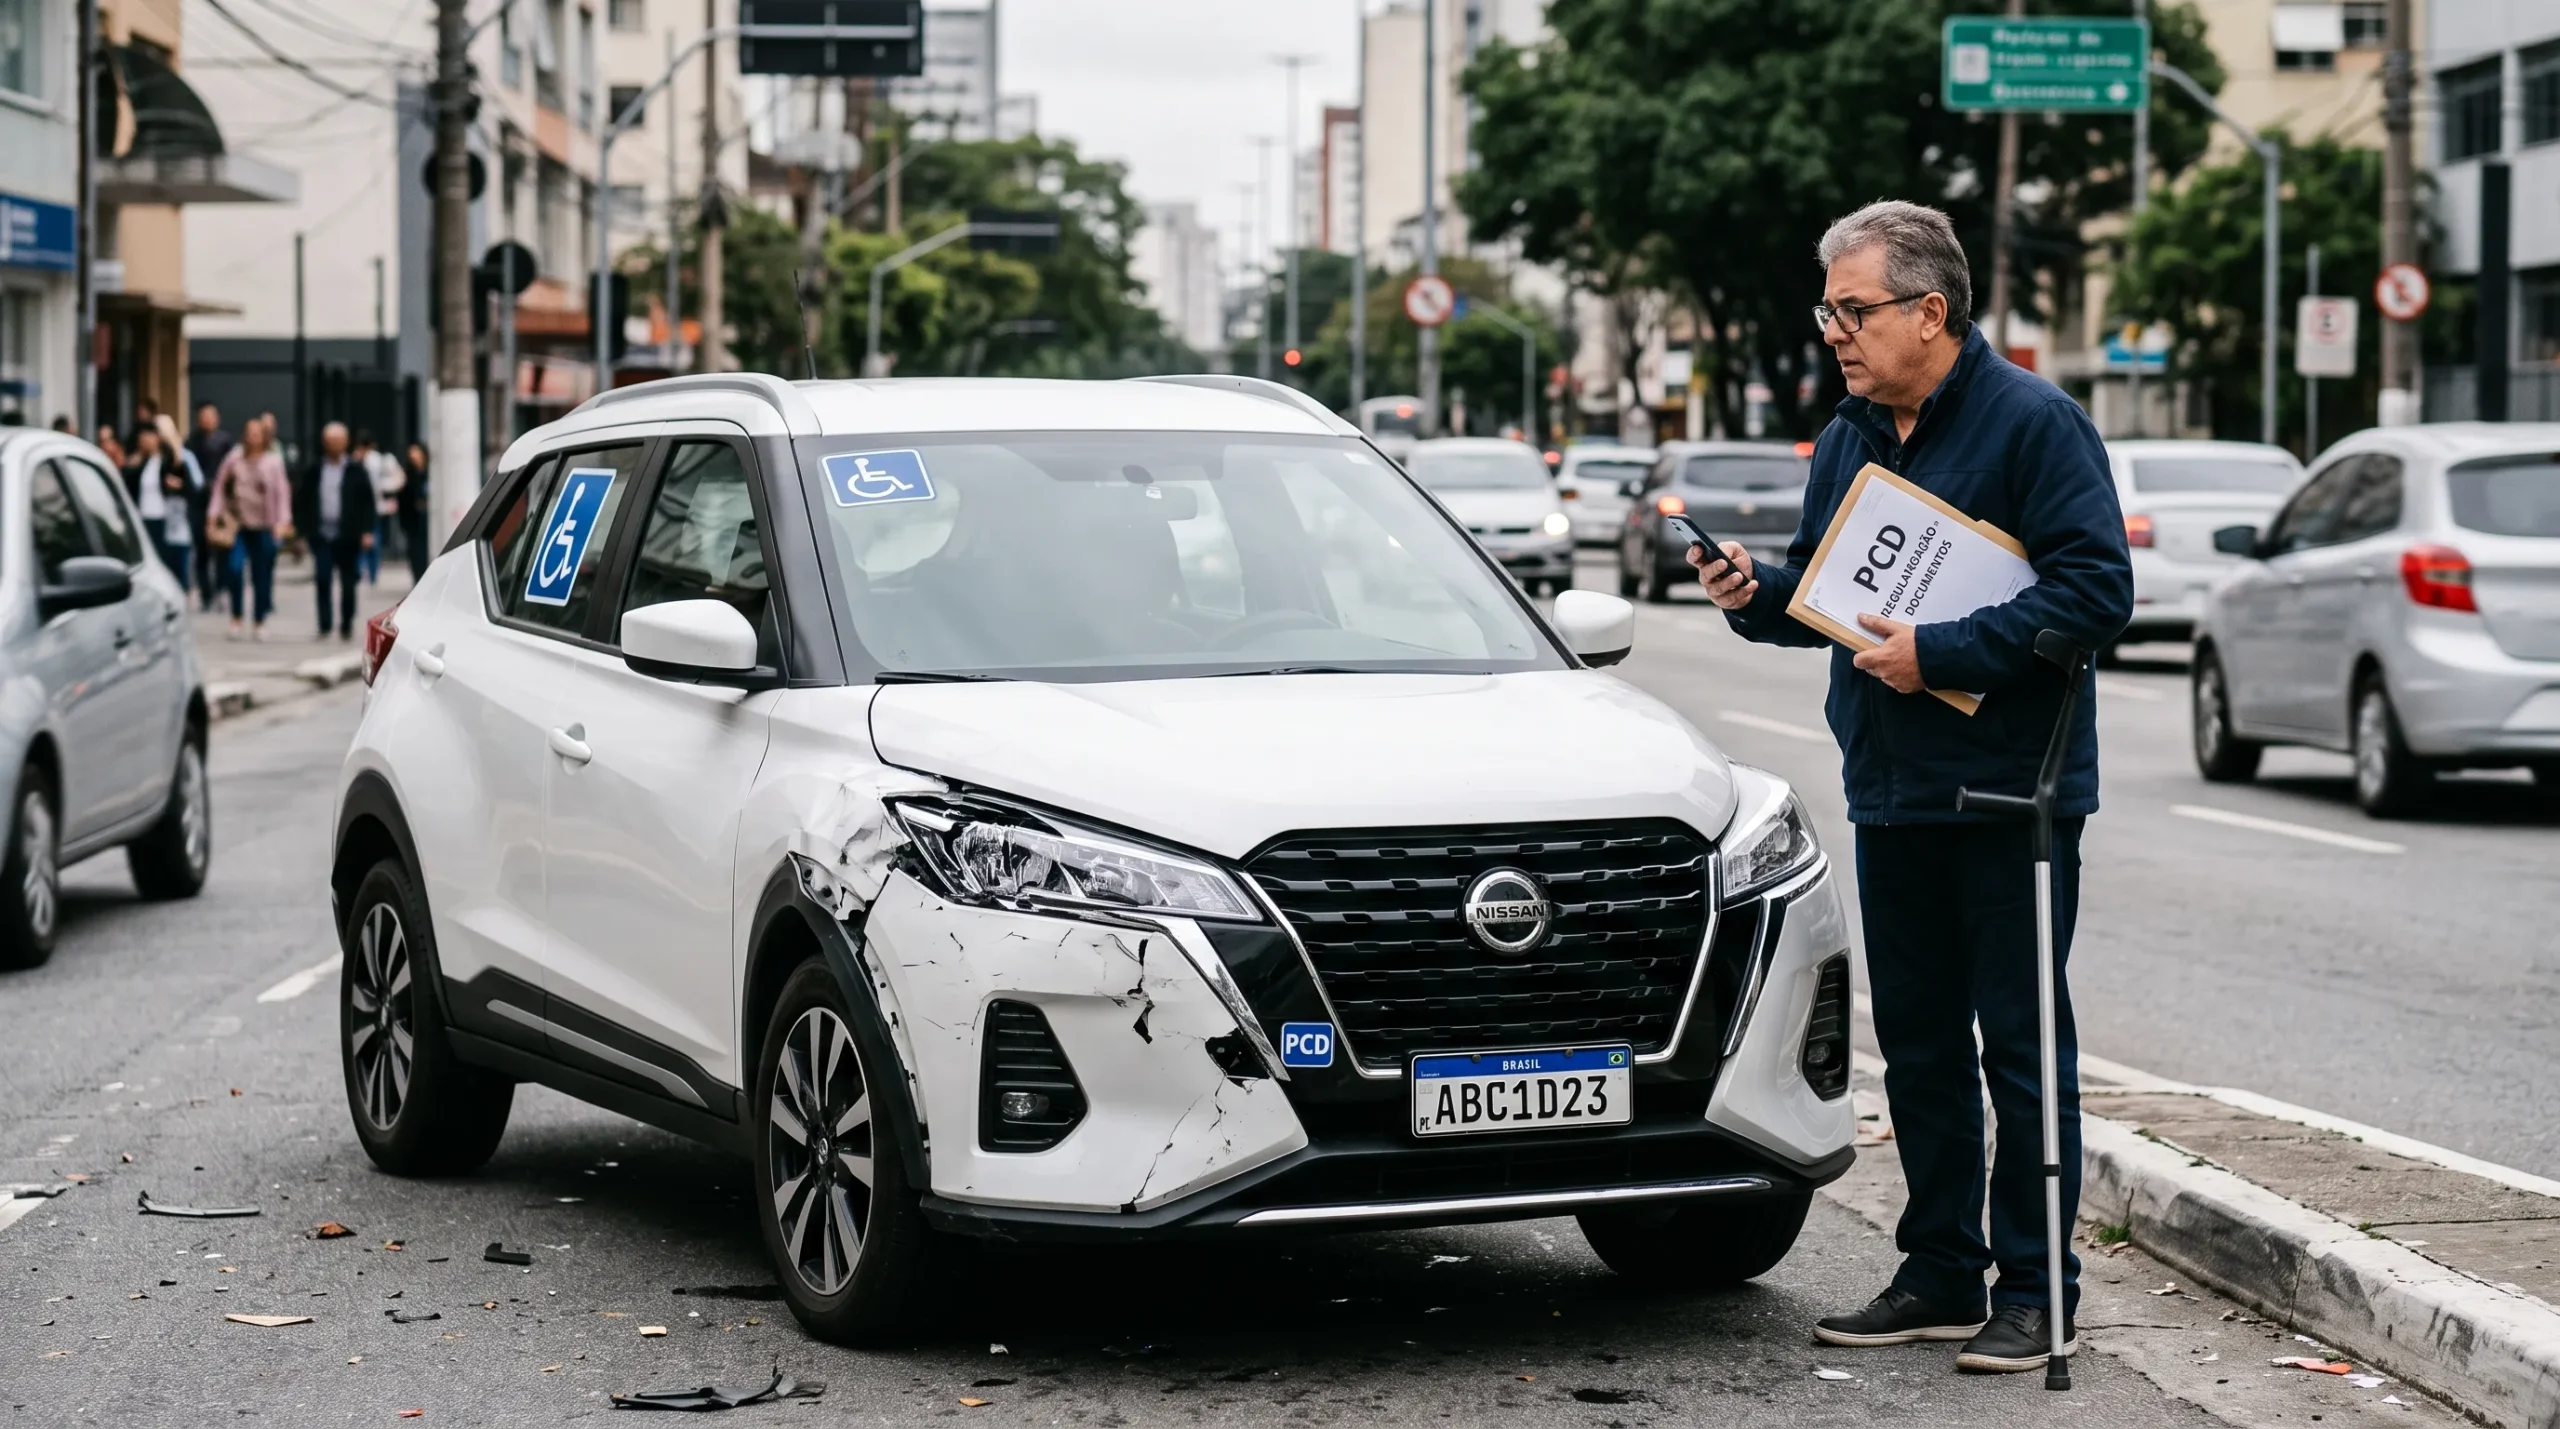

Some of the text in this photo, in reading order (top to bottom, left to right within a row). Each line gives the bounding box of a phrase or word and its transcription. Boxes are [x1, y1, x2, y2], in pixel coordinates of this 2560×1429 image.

[1853, 525, 1906, 593] PCD
[1905, 540, 1952, 616] DOCUMENTOS
[1476, 904, 1545, 919] NISSAN
[1286, 1033, 1330, 1055] PCD
[1502, 1059, 1541, 1071] BRASIL
[1435, 1075, 1608, 1126] ABC1D23
